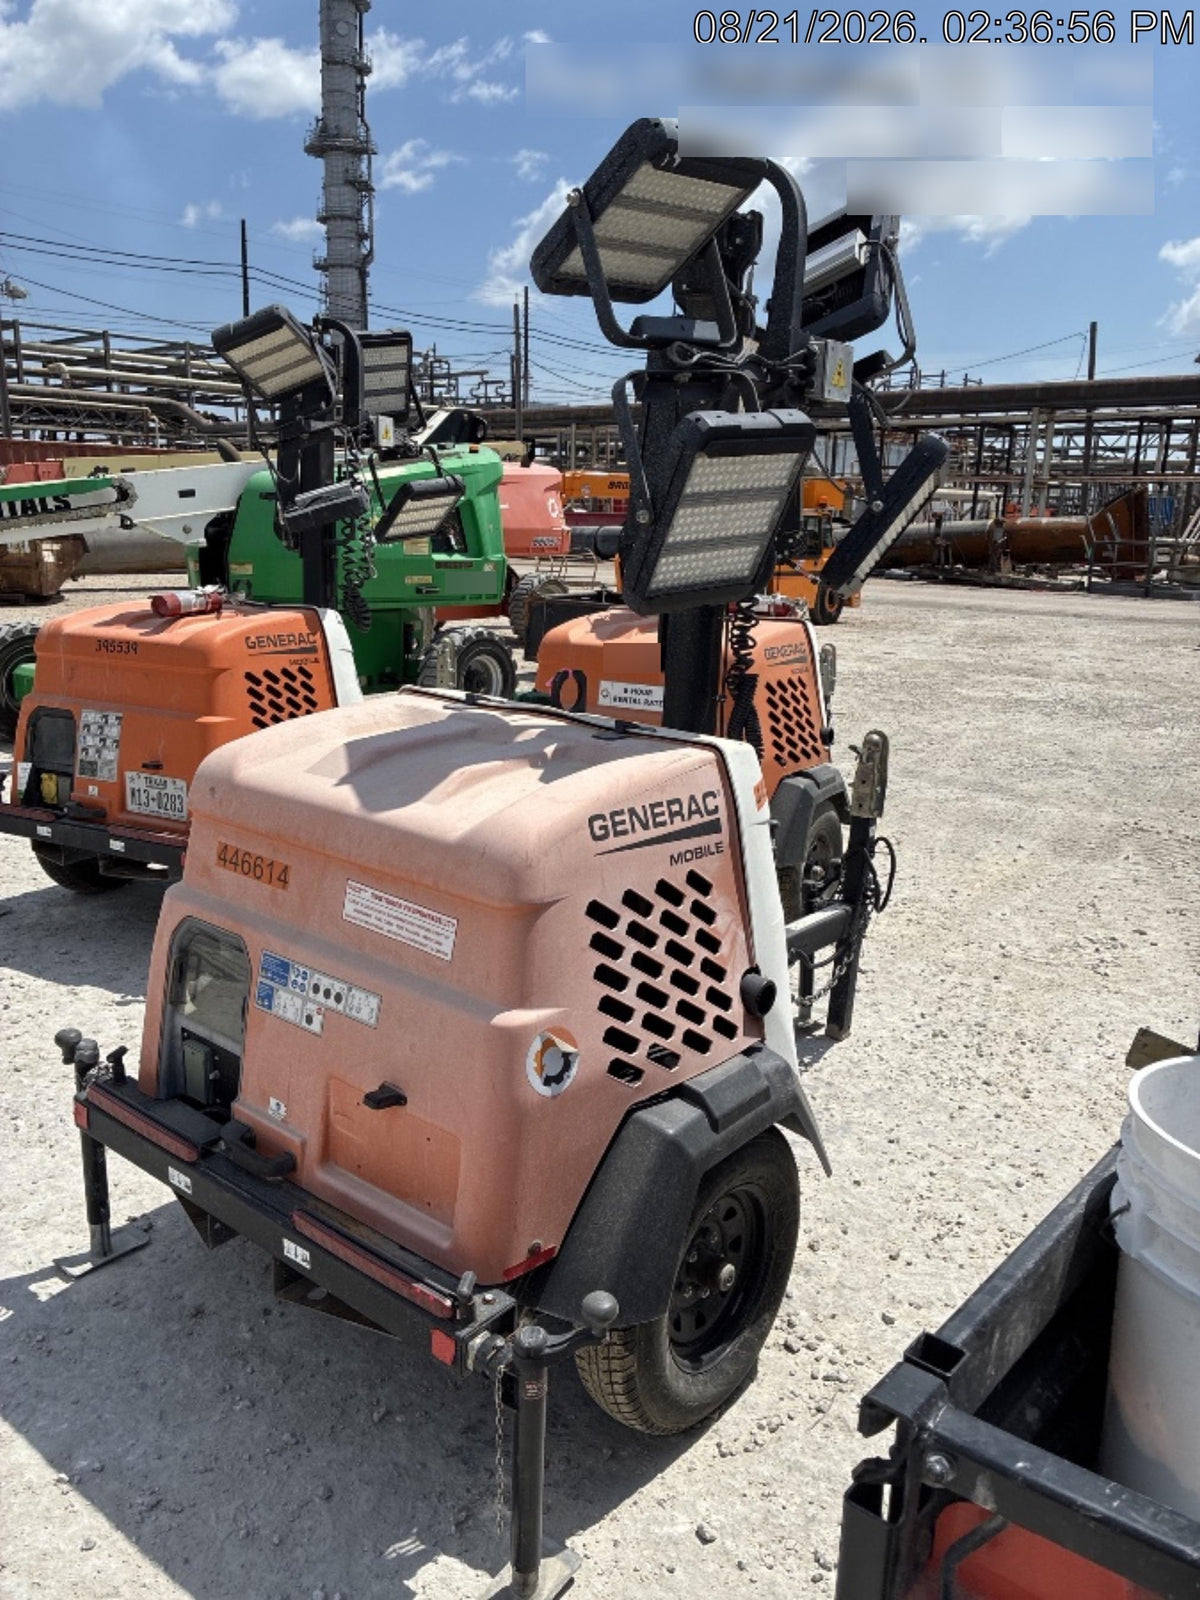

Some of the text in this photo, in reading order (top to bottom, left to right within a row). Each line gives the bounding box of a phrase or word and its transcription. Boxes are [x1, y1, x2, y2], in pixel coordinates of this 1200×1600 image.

[95, 639, 139, 655] 395539
[245, 632, 317, 650] GENERAC
[588, 790, 720, 842] GENERAC
[669, 841, 724, 867] MOBILE
[218, 844, 289, 891] 446614
